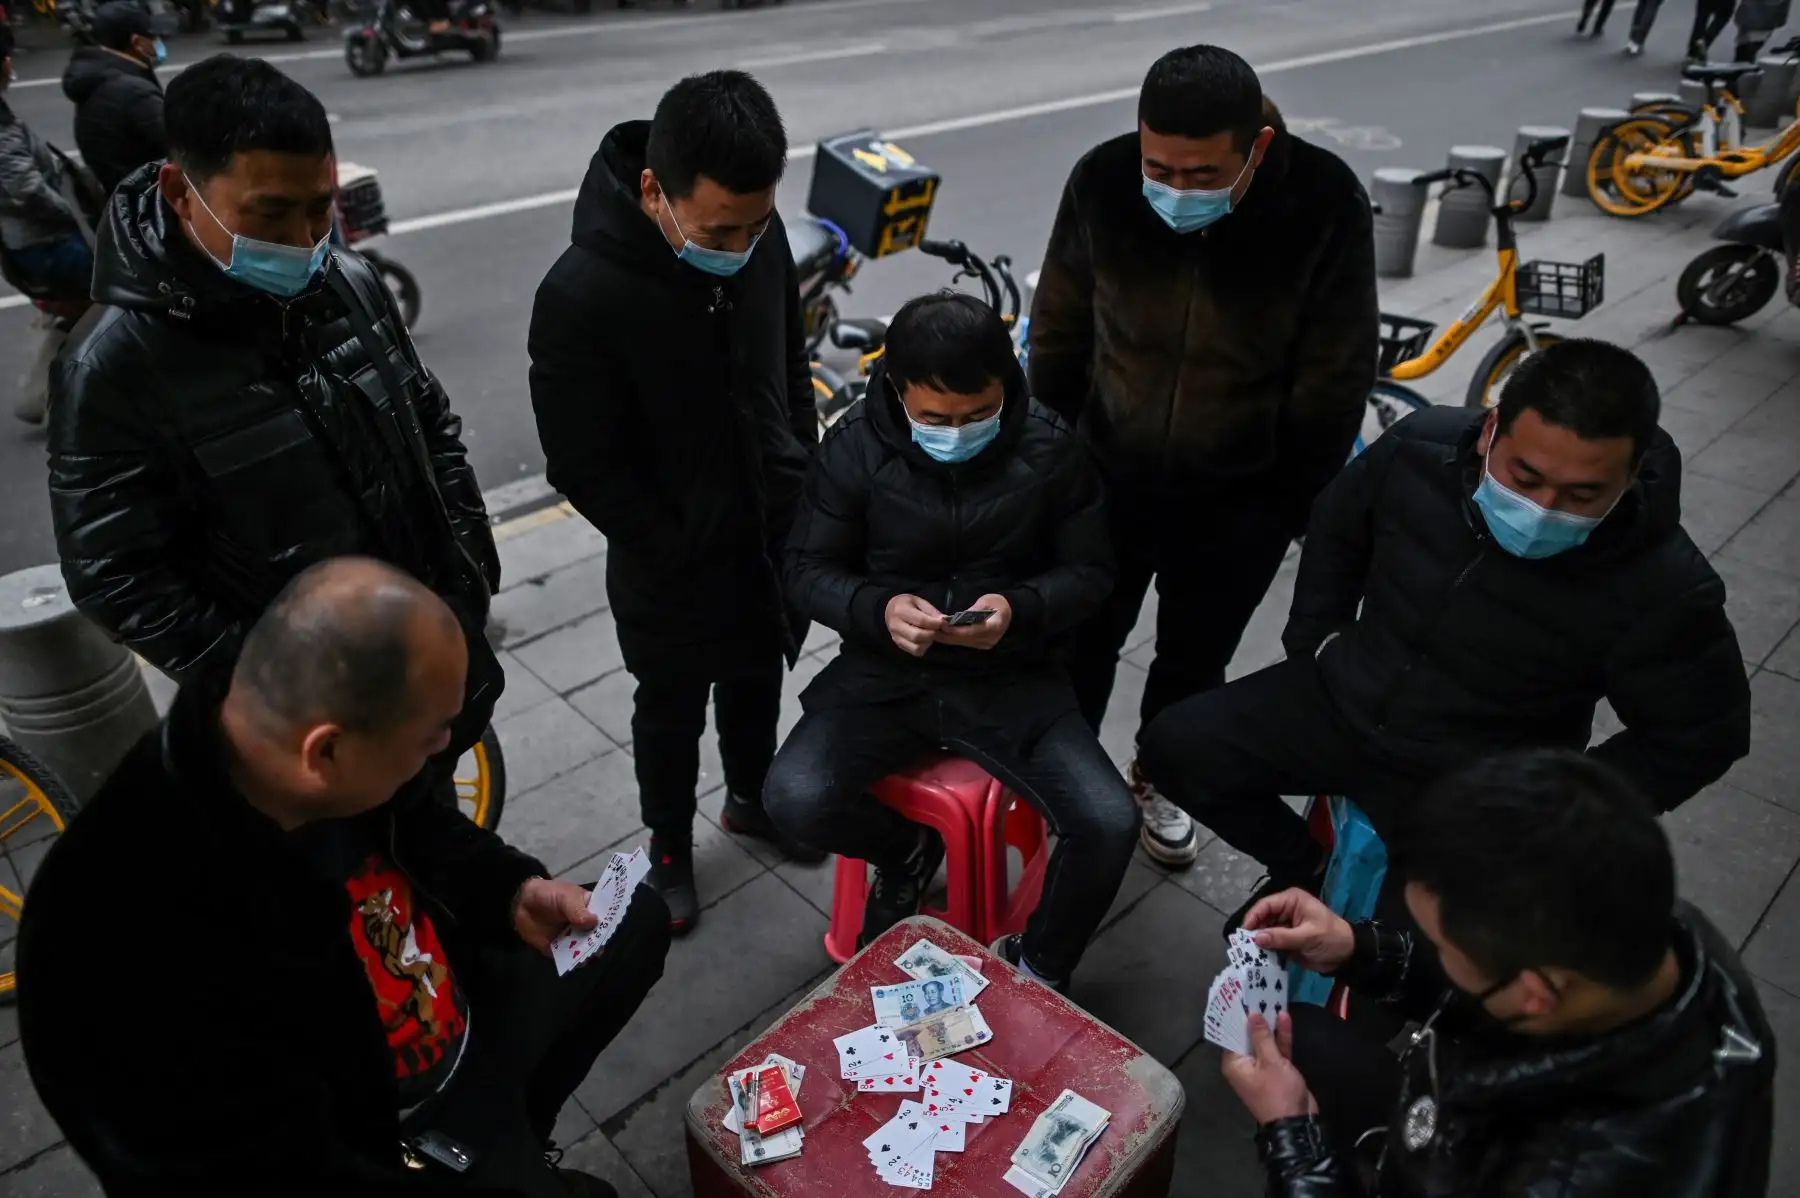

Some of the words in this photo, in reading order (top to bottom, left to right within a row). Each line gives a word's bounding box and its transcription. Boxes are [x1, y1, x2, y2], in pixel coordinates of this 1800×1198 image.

[901, 960, 913, 970] 10
[902, 993, 914, 1003] 10
[937, 1036, 946, 1045] 5
[903, 1109, 911, 1117] 2
[888, 1158, 897, 1167] 2
[1048, 1162, 1062, 1178] 10
